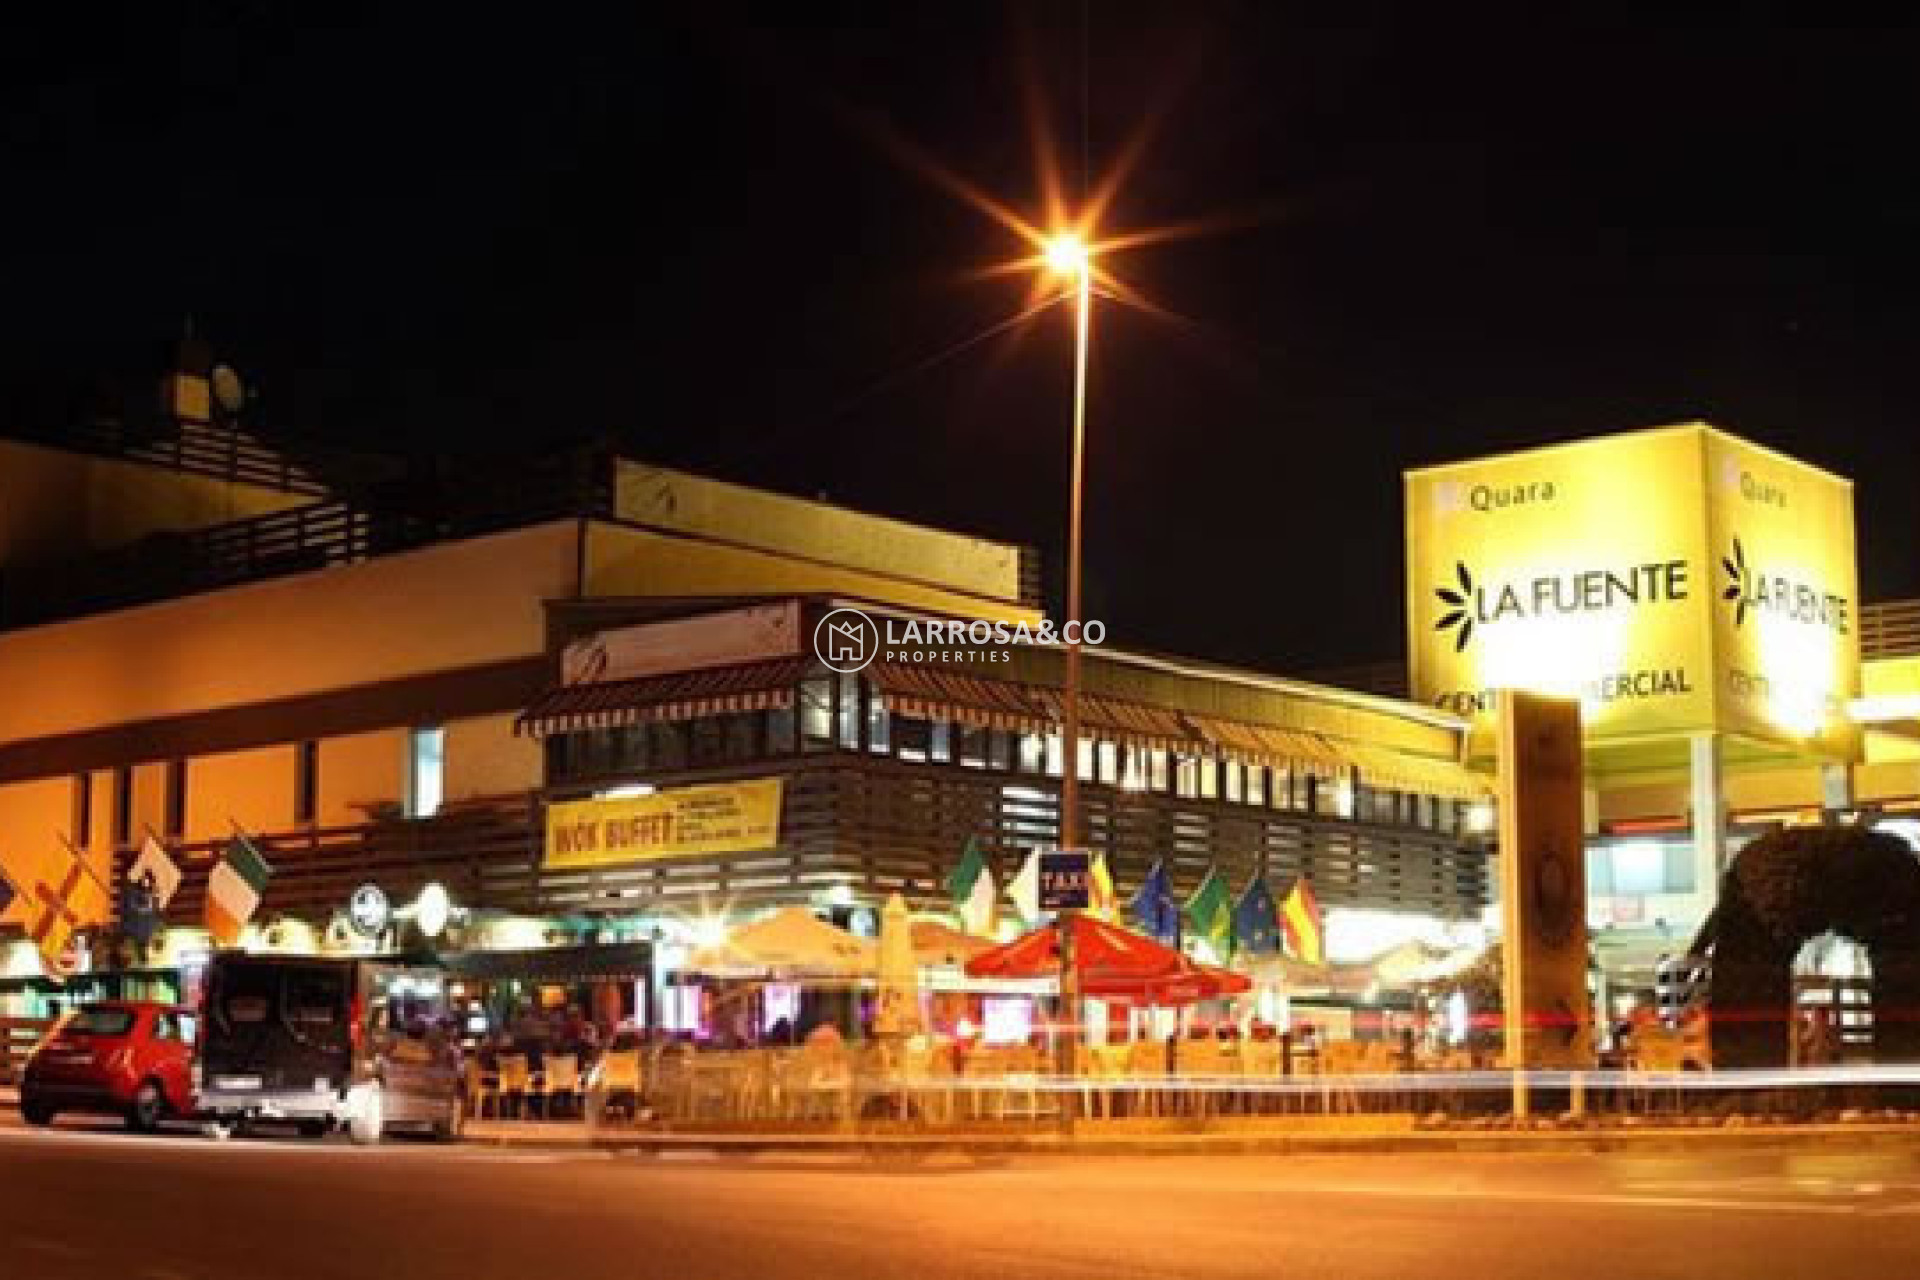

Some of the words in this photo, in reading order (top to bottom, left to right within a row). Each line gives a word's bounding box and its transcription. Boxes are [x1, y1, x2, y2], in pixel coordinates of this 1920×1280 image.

[1470, 480, 1555, 512] Quara
[1475, 583, 1525, 624] LA
[1531, 560, 1688, 616] FUENTE
